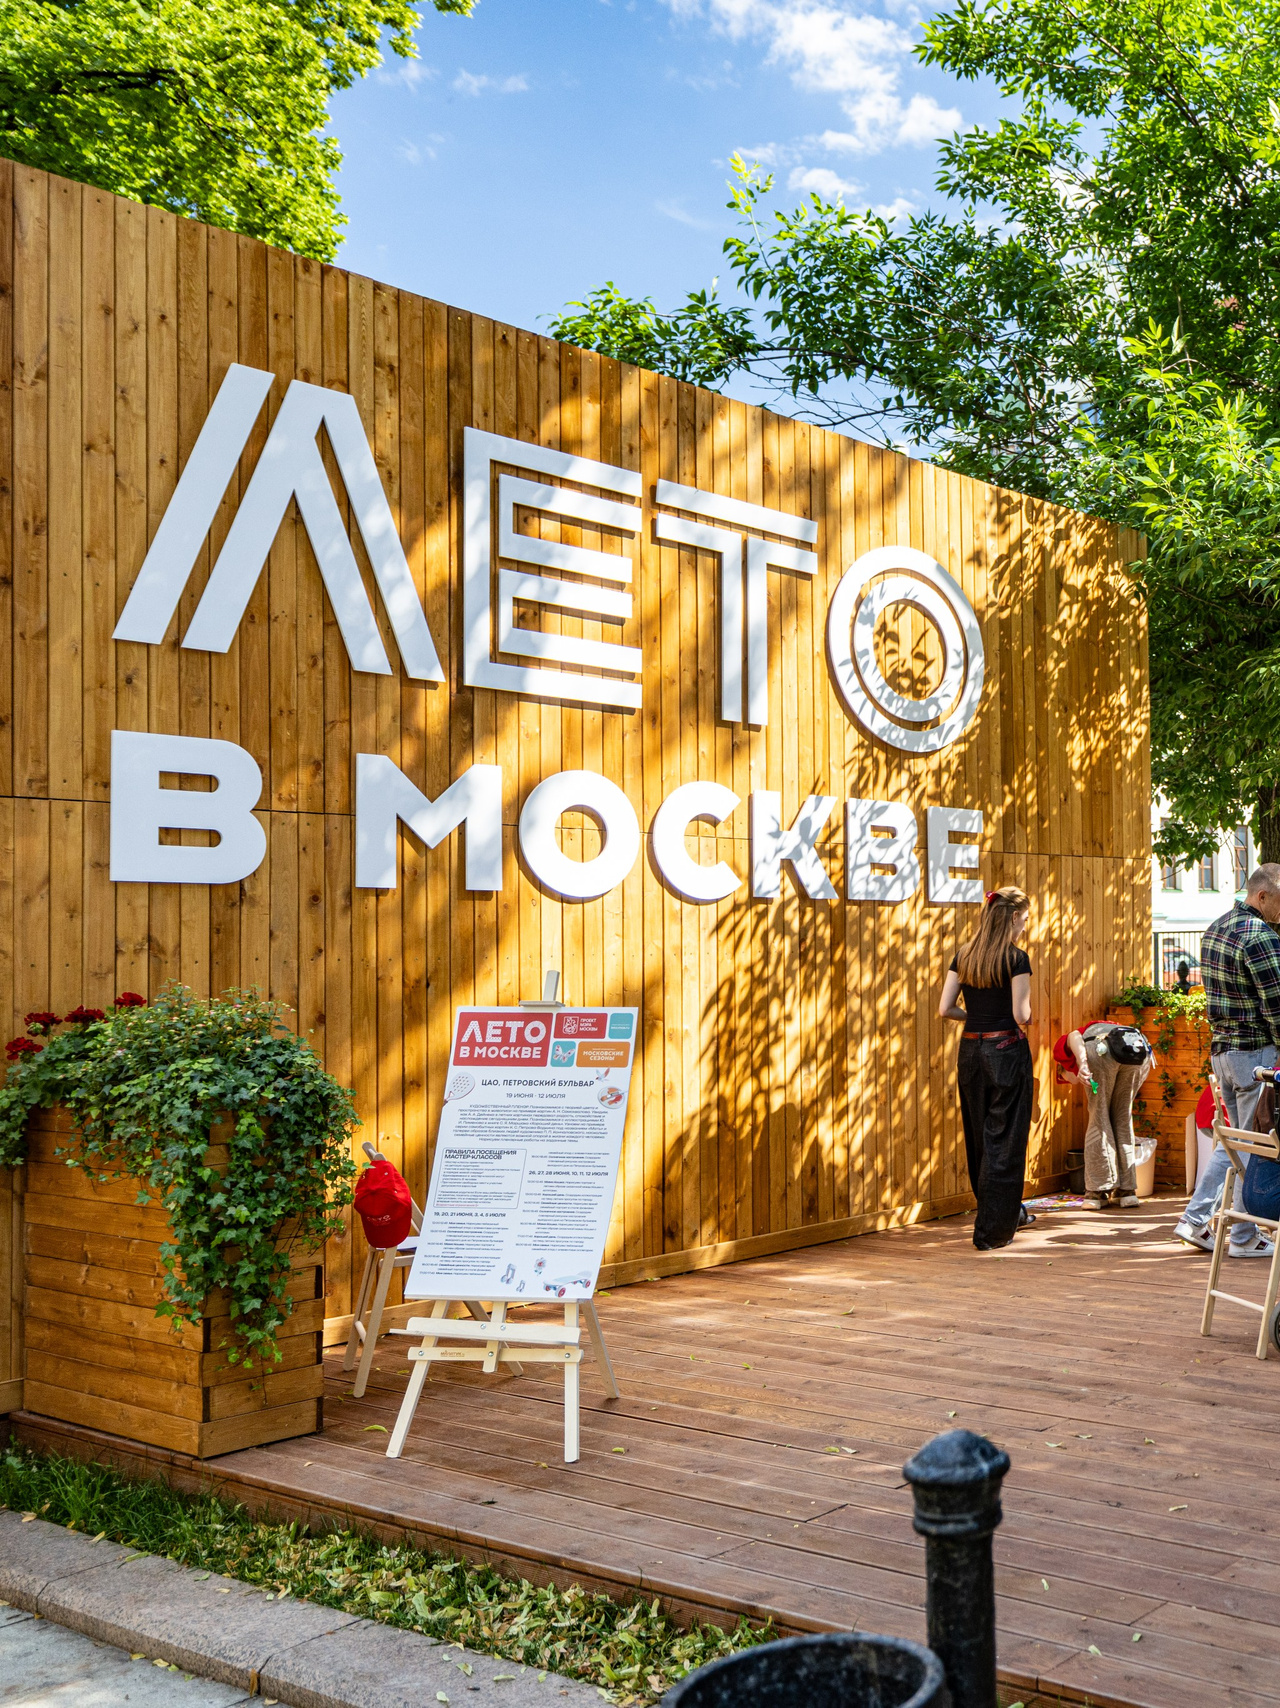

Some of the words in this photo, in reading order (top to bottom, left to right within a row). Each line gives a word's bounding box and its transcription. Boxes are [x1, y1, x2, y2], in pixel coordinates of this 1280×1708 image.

[112, 362, 985, 753] ЛЕТО
[109, 730, 267, 885] В
[355, 751, 985, 904] МОСКВЕ
[459, 1046, 470, 1058] В
[474, 1046, 542, 1058] МОСКВЕ
[460, 1020, 546, 1044] ЛЕТО
